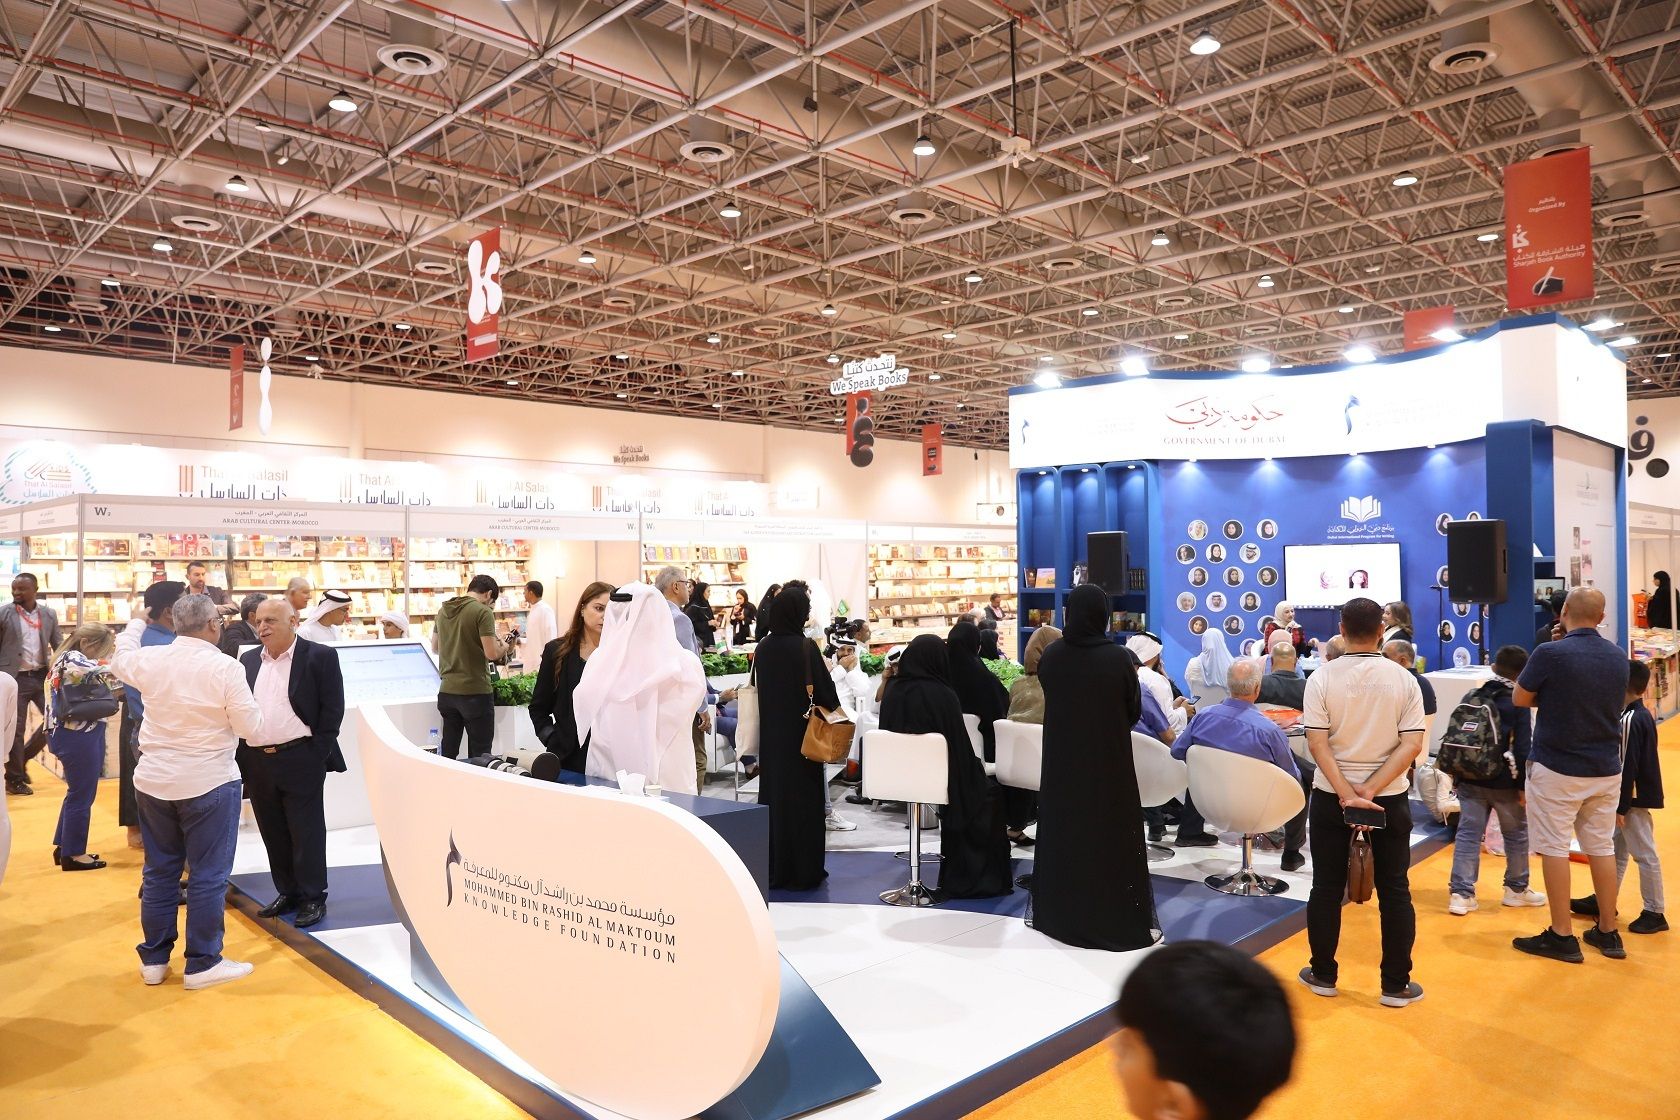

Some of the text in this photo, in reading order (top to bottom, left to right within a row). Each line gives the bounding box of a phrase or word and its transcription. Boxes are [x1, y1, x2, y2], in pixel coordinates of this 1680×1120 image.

[1513, 260, 1536, 268] Sharjah
[1554, 250, 1586, 260] Authority
[832, 372, 906, 392] We Speak Books
[621, 455, 634, 464] Speak
[201, 466, 288, 481] Tha alasil
[360, 473, 382, 486] That
[514, 481, 523, 492] Al
[526, 482, 550, 493] Salas
[464, 859, 675, 927] مؤسسة محمد بن راشد آل مكتوم للمعرفة
[464, 878, 675, 946] MOHAMMED BIN RASHID AL MAKTOUM
[464, 893, 675, 963] KNOWLEDGE FOUNDATION
